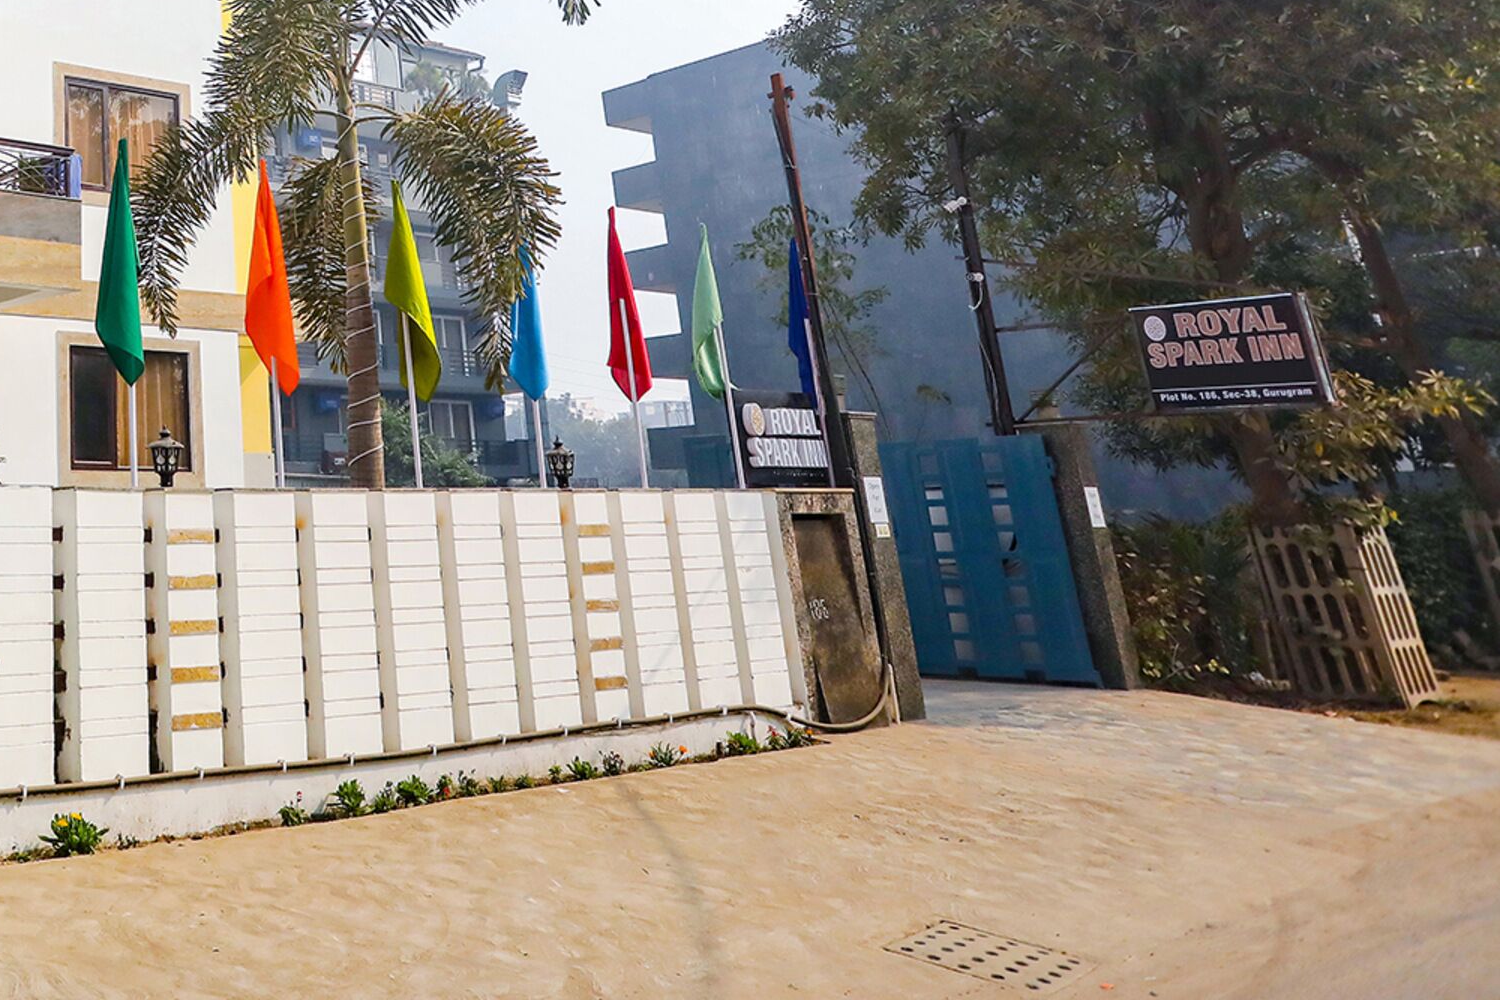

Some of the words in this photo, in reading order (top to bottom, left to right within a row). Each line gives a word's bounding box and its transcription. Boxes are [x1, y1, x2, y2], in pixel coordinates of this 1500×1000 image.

[1173, 305, 1287, 338] ROYAL
[1147, 337, 1244, 369] SPARK
[1247, 332, 1305, 362] INN
[1160, 393, 1180, 402] Plot
[1180, 391, 1197, 401] No.
[1262, 387, 1314, 398] Gurugram
[768, 408, 822, 435] ROYAL
[750, 437, 803, 467] SPARK
[802, 438, 829, 468] INN
